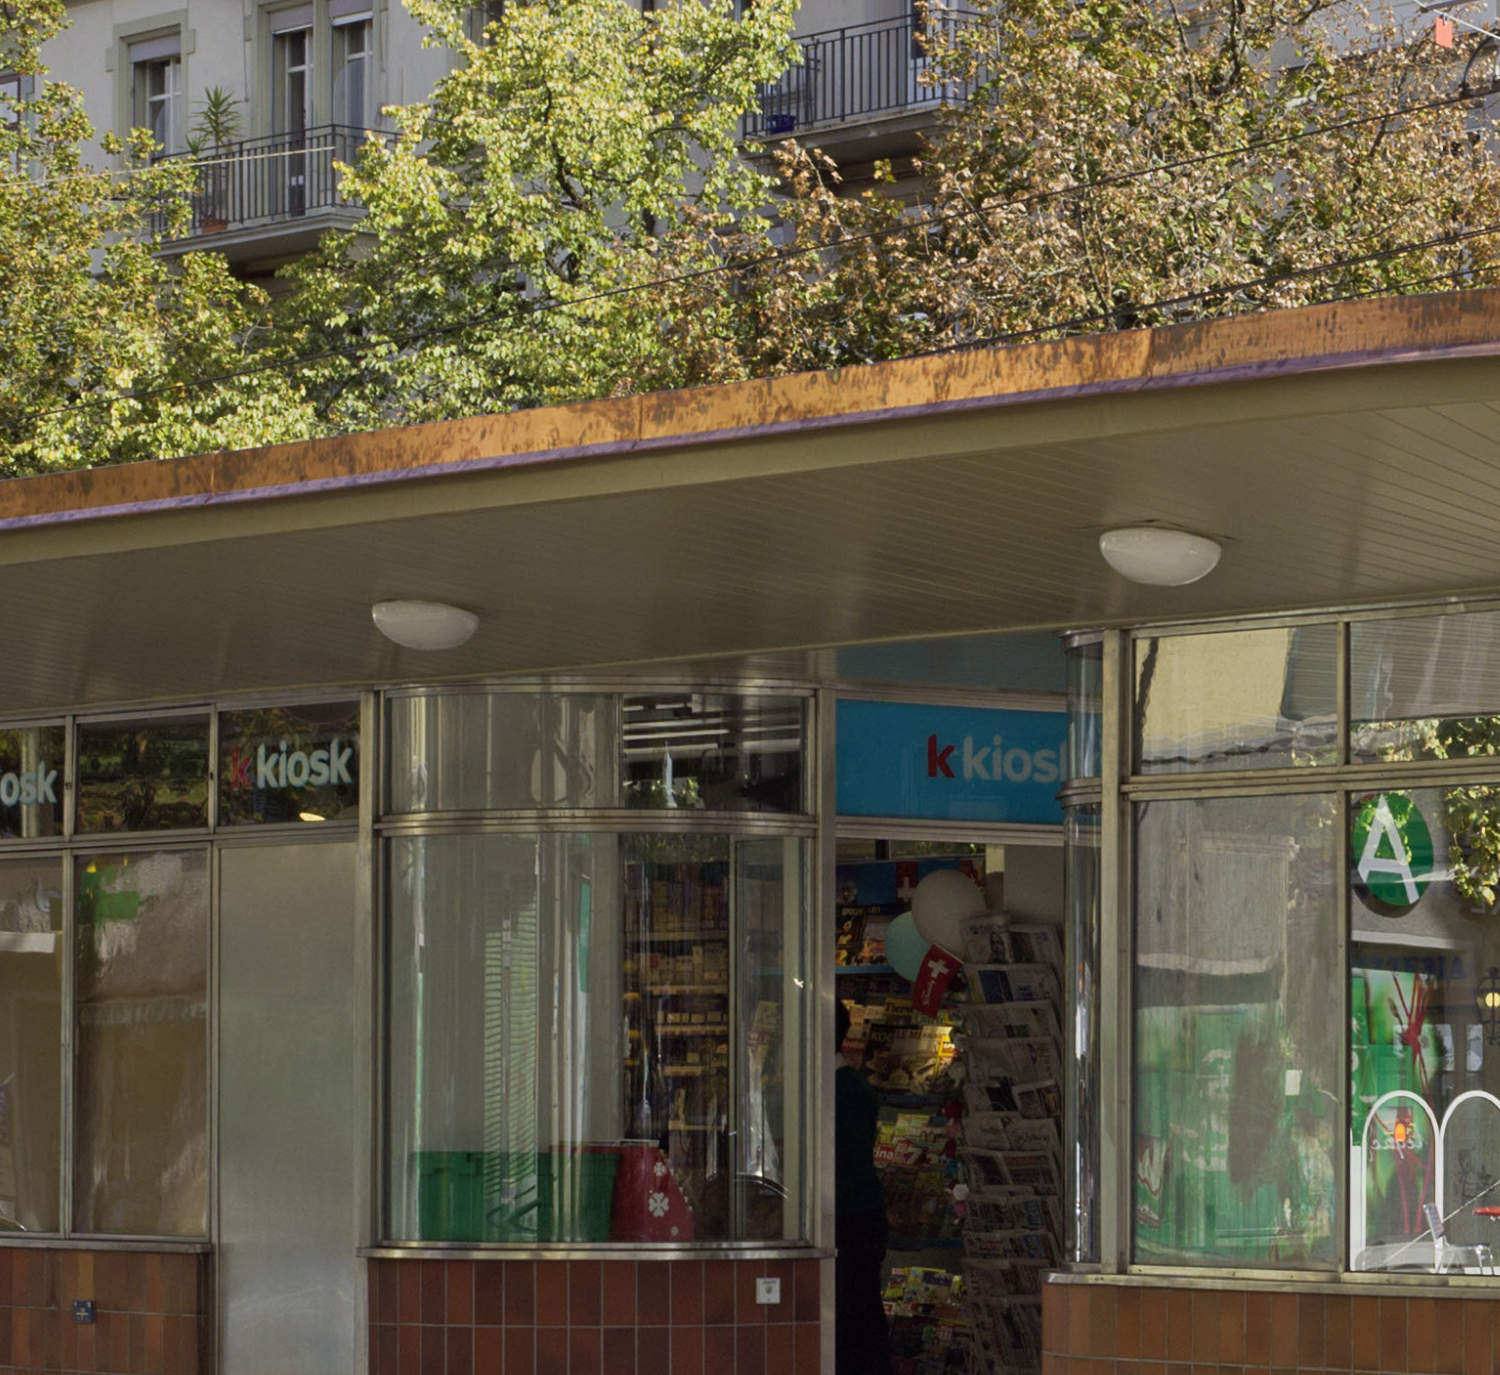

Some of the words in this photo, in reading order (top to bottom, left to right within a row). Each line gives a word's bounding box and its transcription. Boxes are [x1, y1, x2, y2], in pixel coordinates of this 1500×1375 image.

[231, 743, 252, 791] k
[257, 737, 353, 790] kiosk
[928, 733, 956, 778] k
